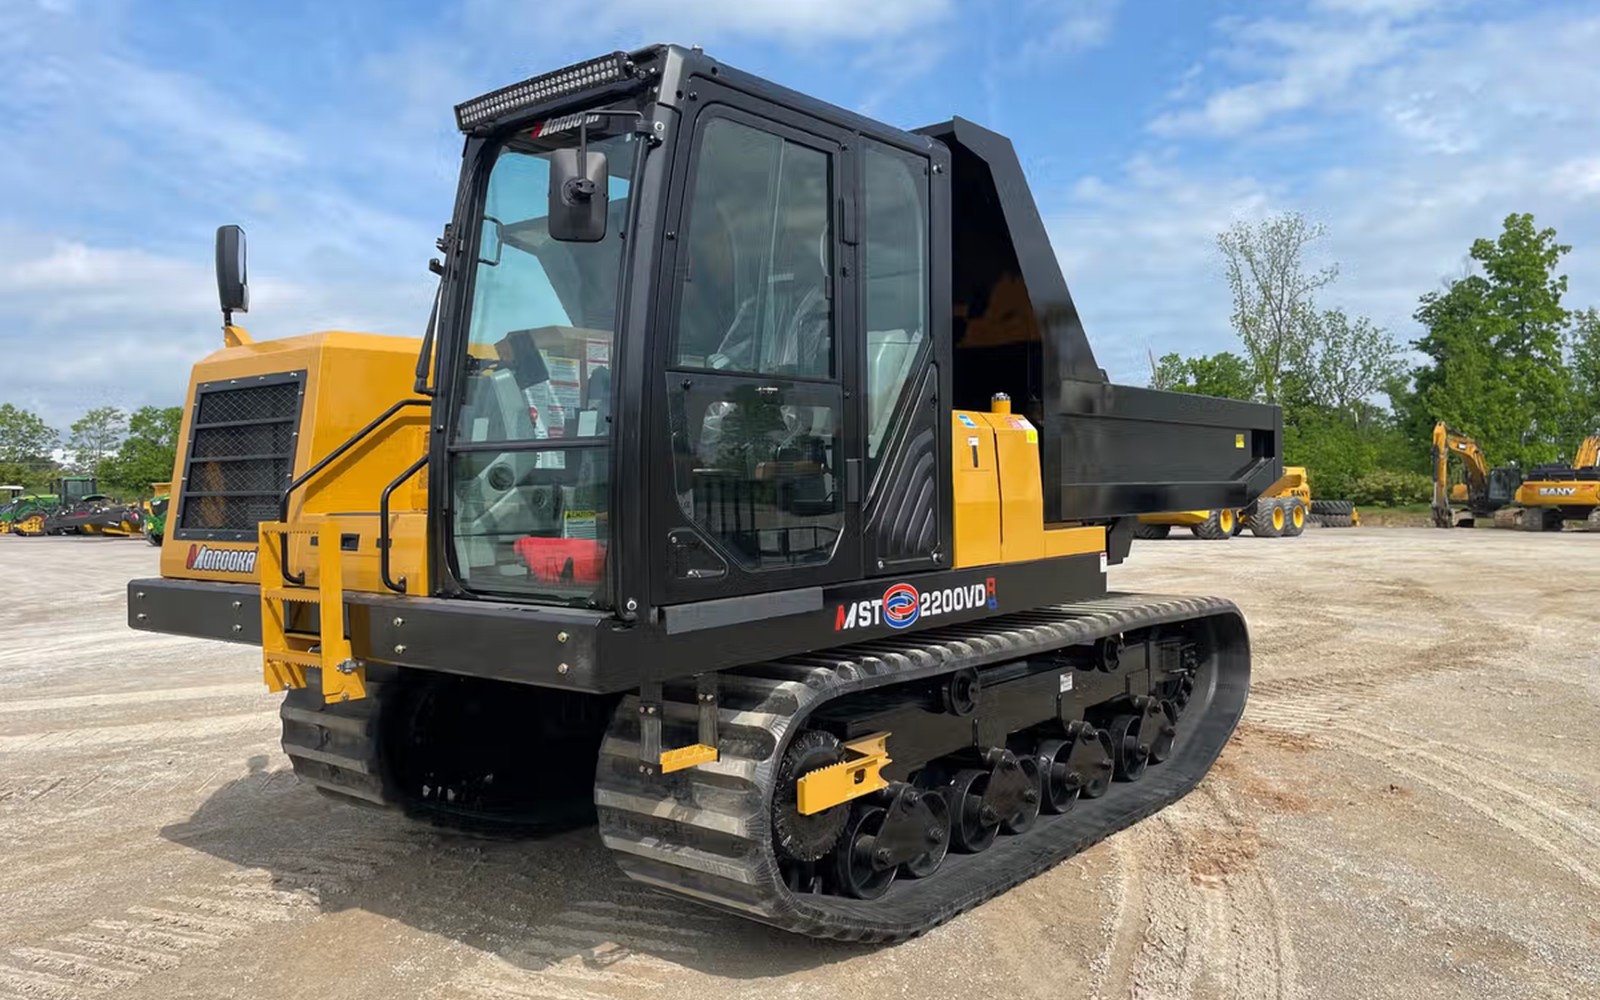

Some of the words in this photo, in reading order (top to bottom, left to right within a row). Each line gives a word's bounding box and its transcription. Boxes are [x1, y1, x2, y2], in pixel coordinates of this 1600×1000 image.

[1539, 487, 1577, 497] SANY
[186, 544, 258, 573] MOROOKA
[835, 599, 883, 631] MST
